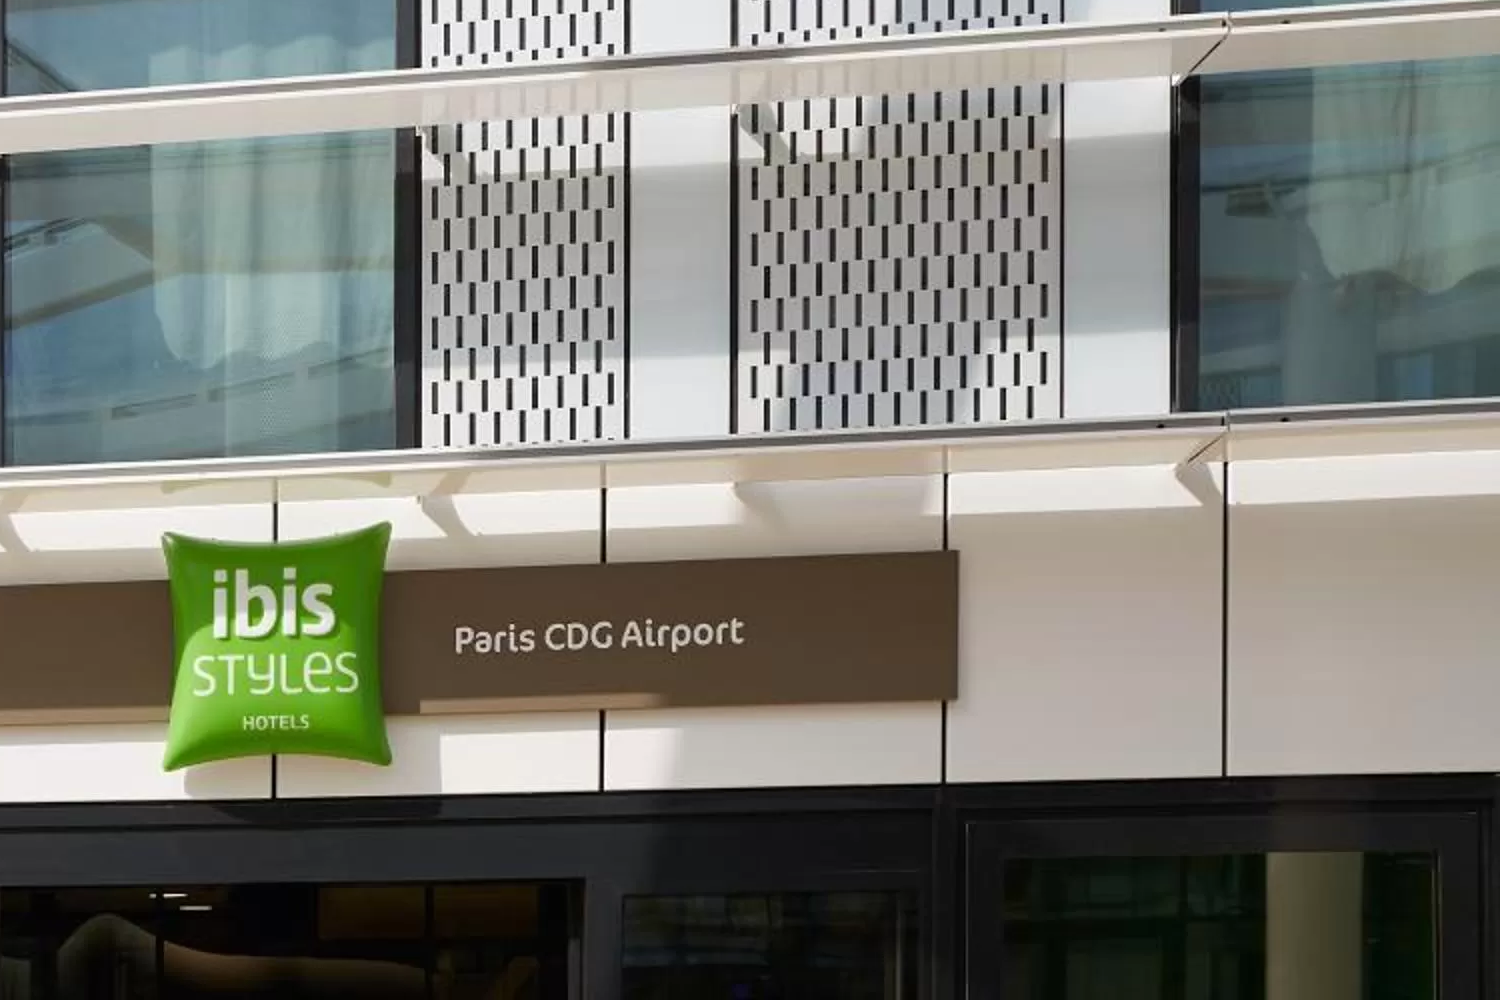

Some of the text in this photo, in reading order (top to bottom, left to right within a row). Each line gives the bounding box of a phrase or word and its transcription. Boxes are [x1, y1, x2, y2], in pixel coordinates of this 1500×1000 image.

[213, 567, 336, 639] ibis
[455, 617, 744, 654] Paris CDG Airport
[242, 714, 310, 731] HOTELS
